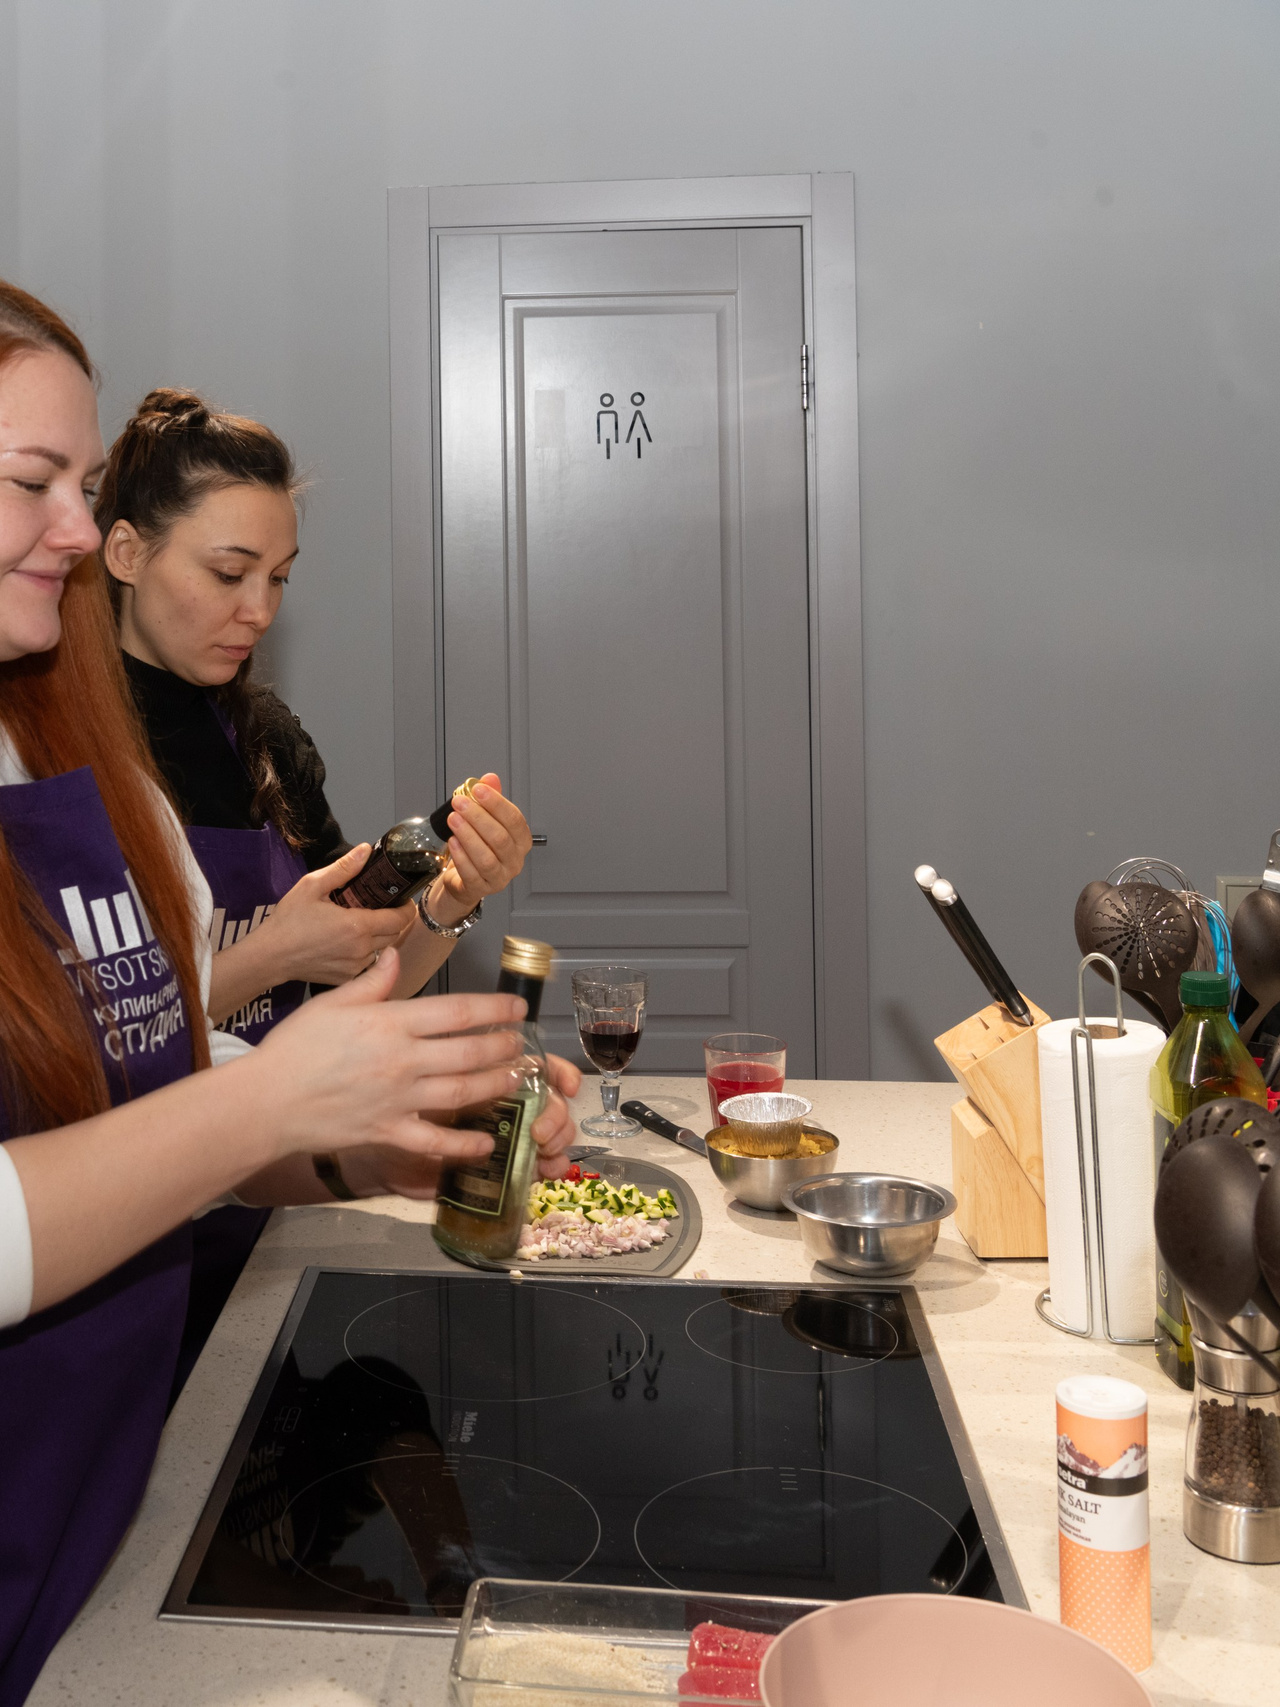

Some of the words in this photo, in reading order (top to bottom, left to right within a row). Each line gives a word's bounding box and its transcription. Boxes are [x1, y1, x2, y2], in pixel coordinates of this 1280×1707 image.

[104, 998, 185, 1062] СТУДИЯ
[459, 1411, 479, 1443] Miele
[1067, 1494, 1102, 1515] SALT
